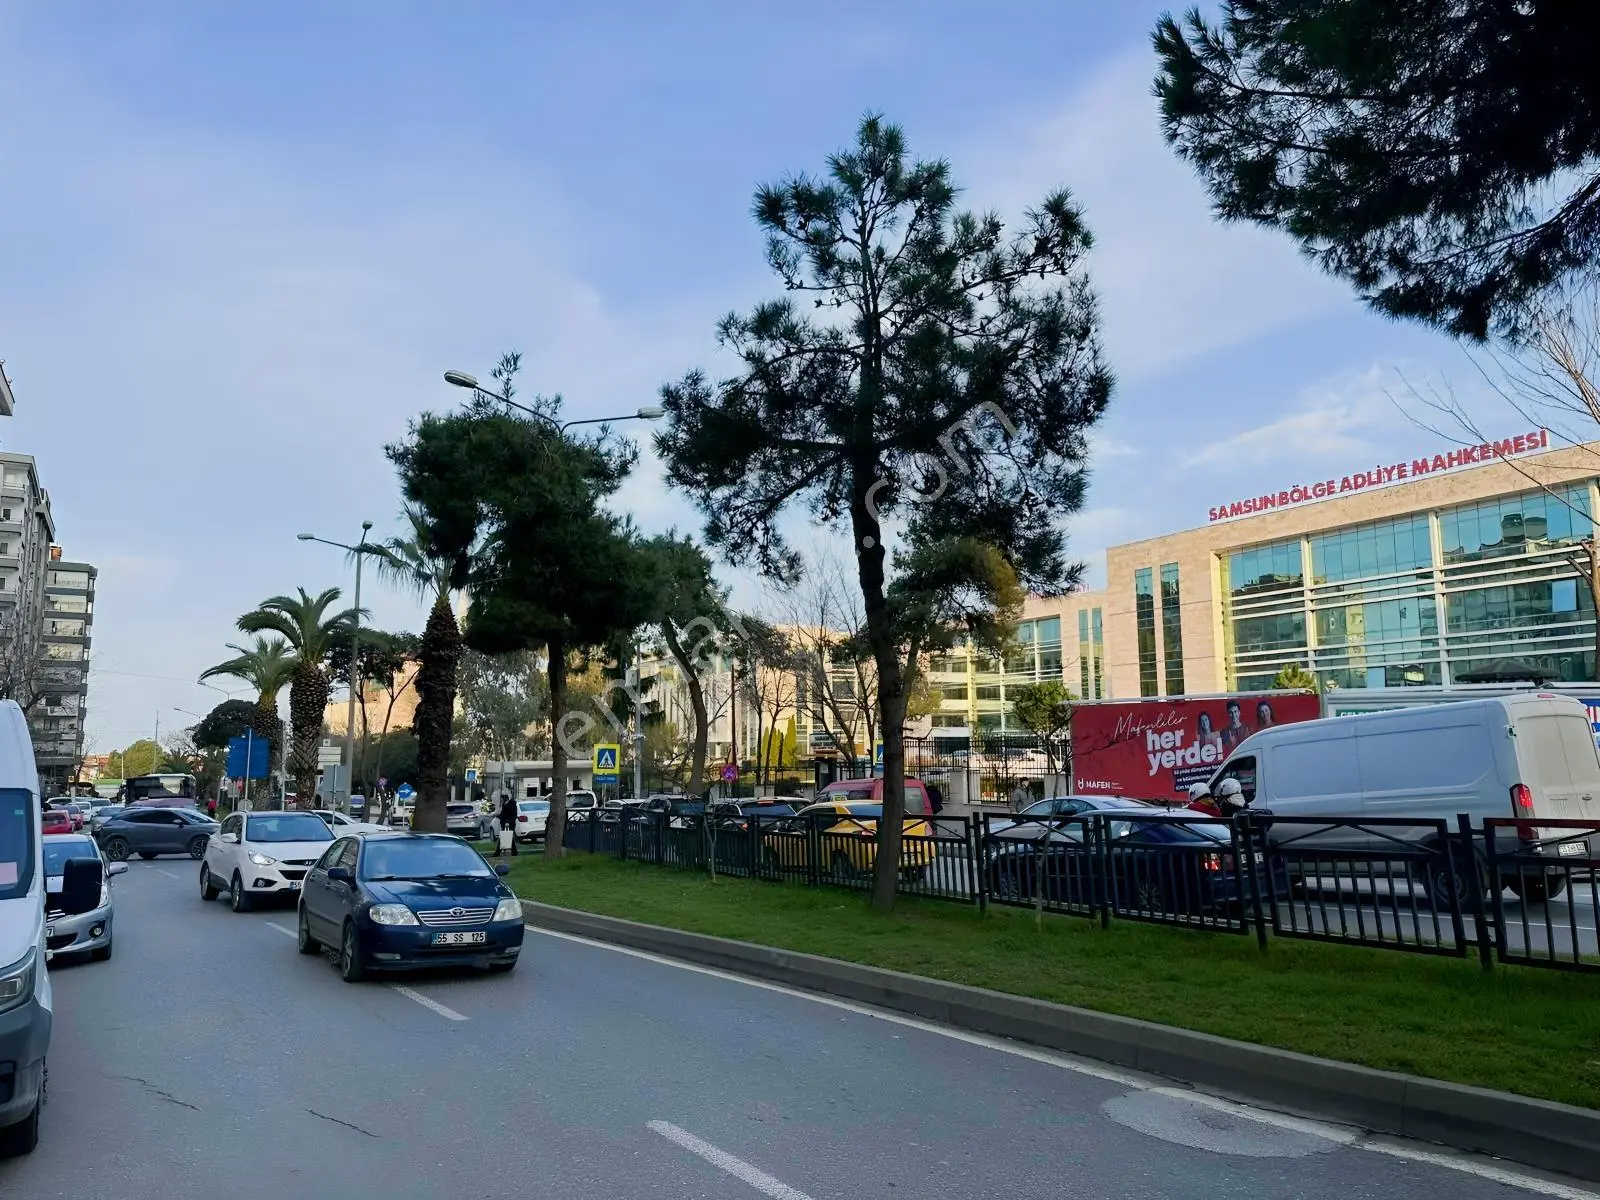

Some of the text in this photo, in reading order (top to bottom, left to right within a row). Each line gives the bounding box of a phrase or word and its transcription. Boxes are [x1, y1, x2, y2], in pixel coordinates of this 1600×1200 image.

[1209, 494, 1276, 521] SAMSUN
[1278, 485, 1336, 506] BÖLGE
[1340, 463, 1407, 493] ADLİYE
[1146, 728, 1184, 751] her
[1147, 737, 1223, 776] yerde!
[437, 932, 485, 943] 55 SS 125
